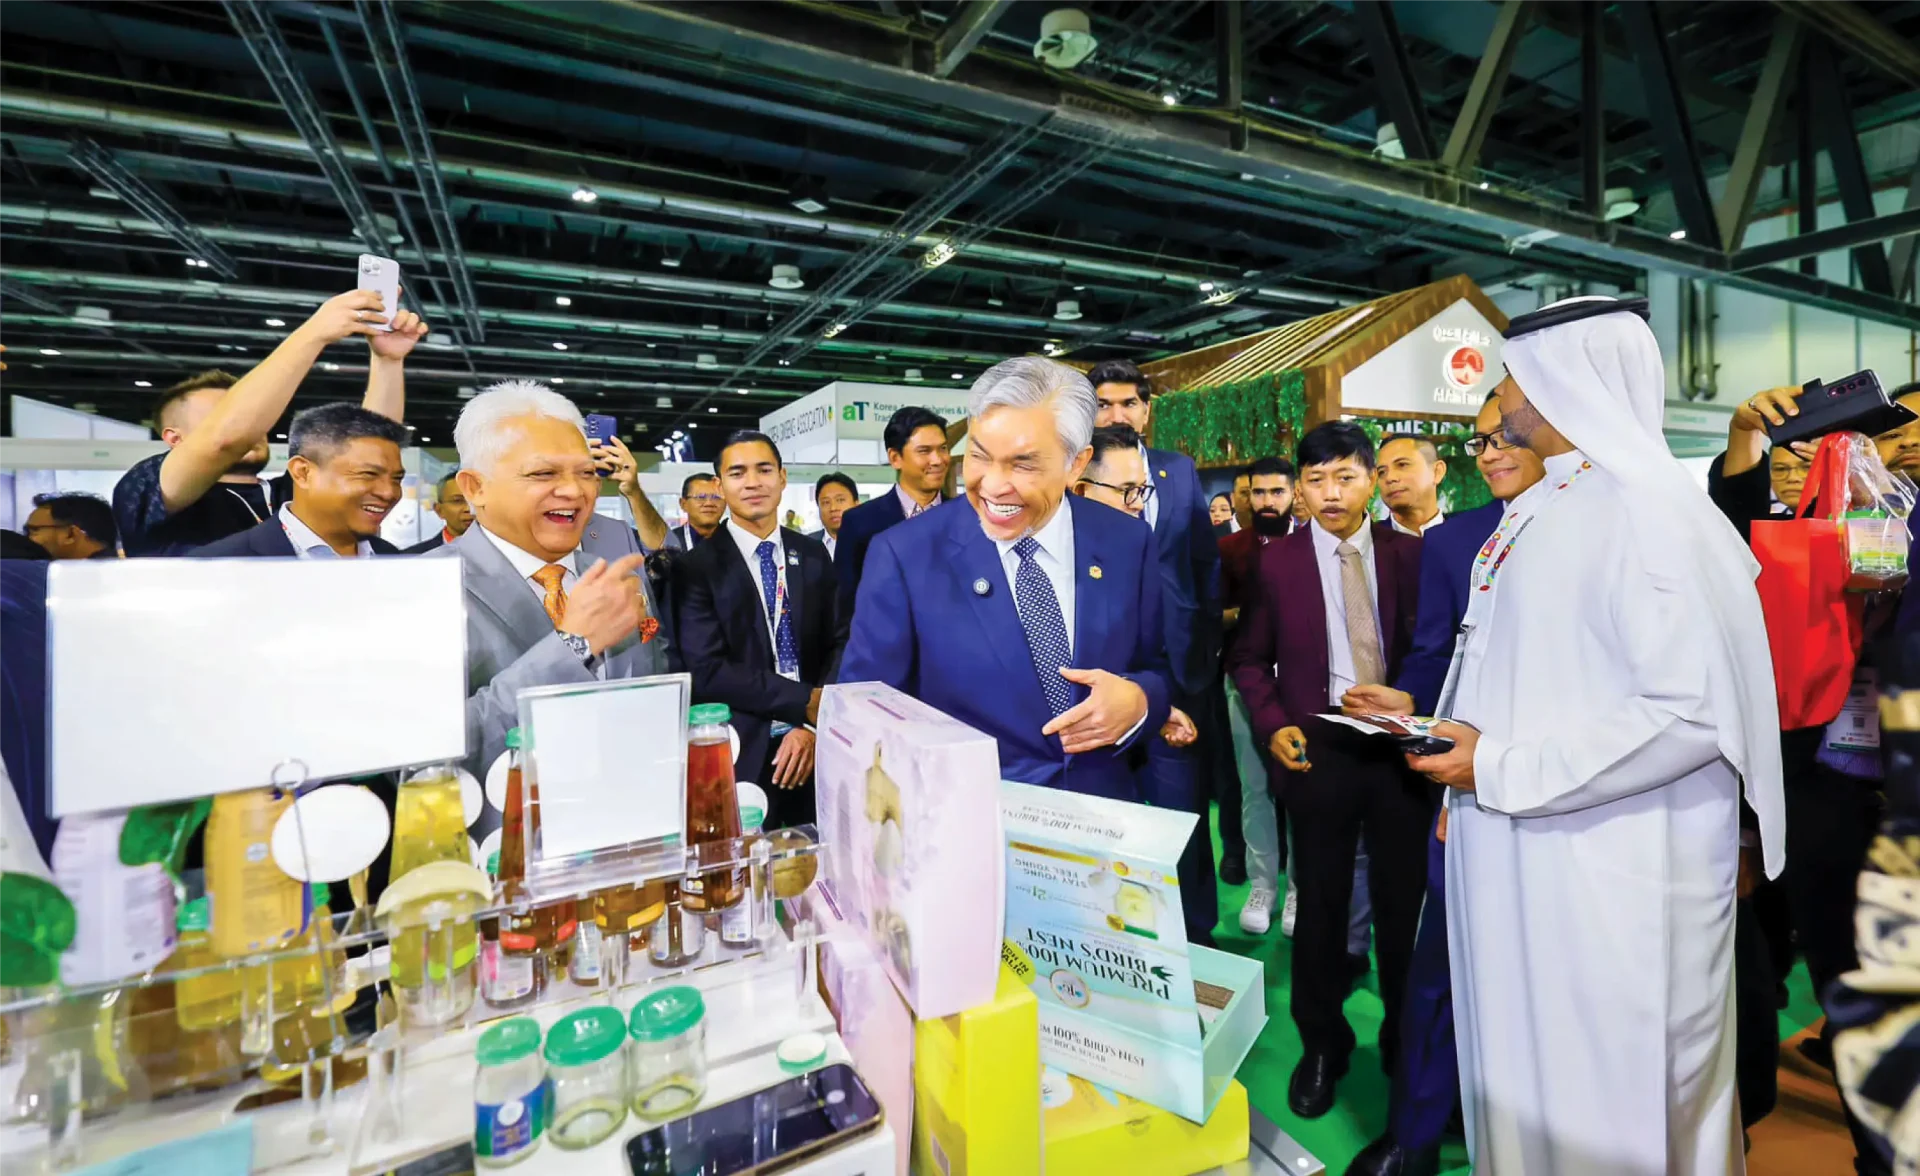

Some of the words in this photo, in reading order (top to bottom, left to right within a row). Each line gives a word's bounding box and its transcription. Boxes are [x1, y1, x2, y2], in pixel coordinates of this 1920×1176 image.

[842, 401, 870, 421] aT
[873, 402, 898, 412] Korea
[874, 413, 892, 422] Trad
[1014, 858, 1050, 872] YOUNG
[1052, 866, 1078, 879] FEEL
[1023, 868, 1057, 882] YOUNG
[1062, 877, 1088, 889] STAY
[1027, 928, 1074, 950] NEST
[1001, 950, 1025, 976] ALIC
[1080, 944, 1147, 973] BIRD'S
[1066, 954, 1169, 1000] PREMIUM
[1053, 1025, 1081, 1044] 100%
[1083, 1037, 1116, 1056] BIRD'S
[1118, 1049, 1144, 1067] NEST
